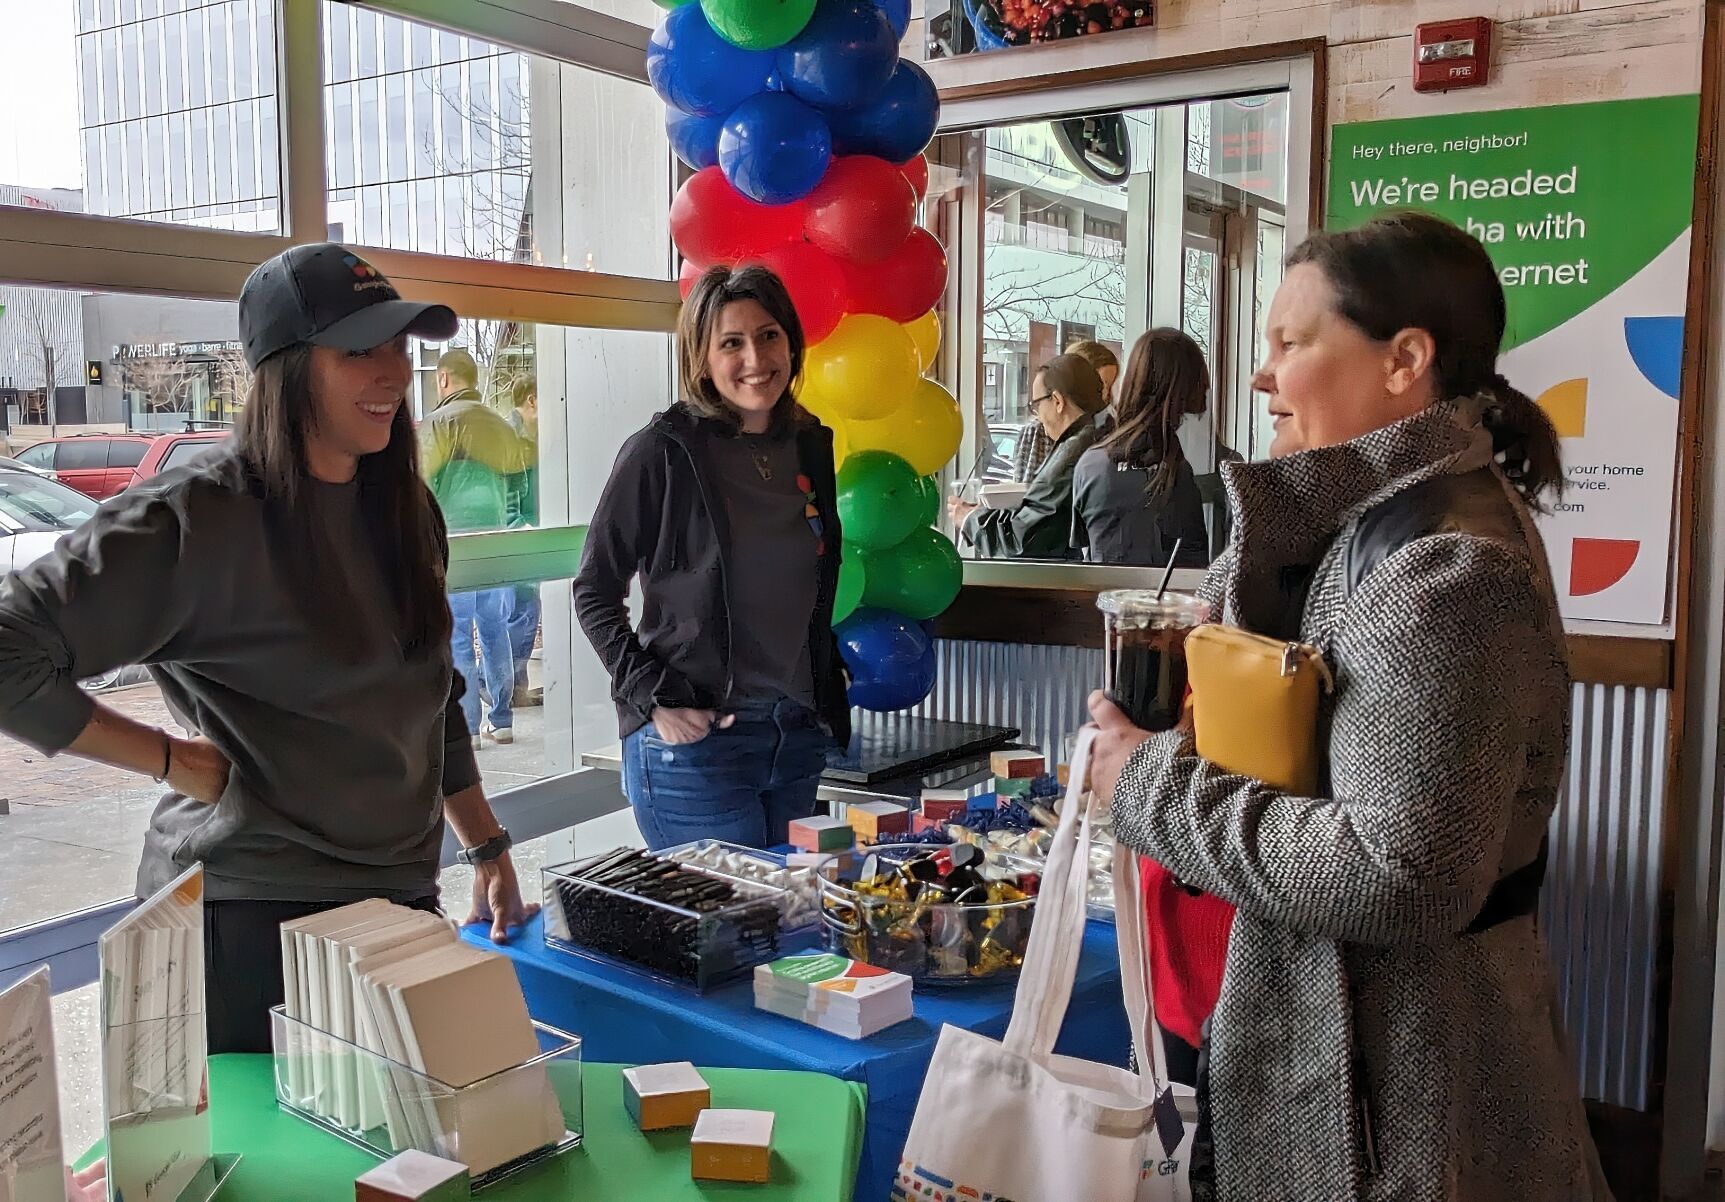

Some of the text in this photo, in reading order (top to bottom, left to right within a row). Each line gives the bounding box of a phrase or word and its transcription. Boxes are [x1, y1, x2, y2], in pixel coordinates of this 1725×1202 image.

[1449, 66, 1472, 78] FIRE
[1352, 131, 1528, 161] Hey there, neighbor!
[1350, 166, 1577, 208] We're headed
[1465, 211, 1586, 243] ha with
[1497, 258, 1589, 287] ernet
[1567, 463, 1645, 476] your home
[1553, 502, 1585, 513] com
